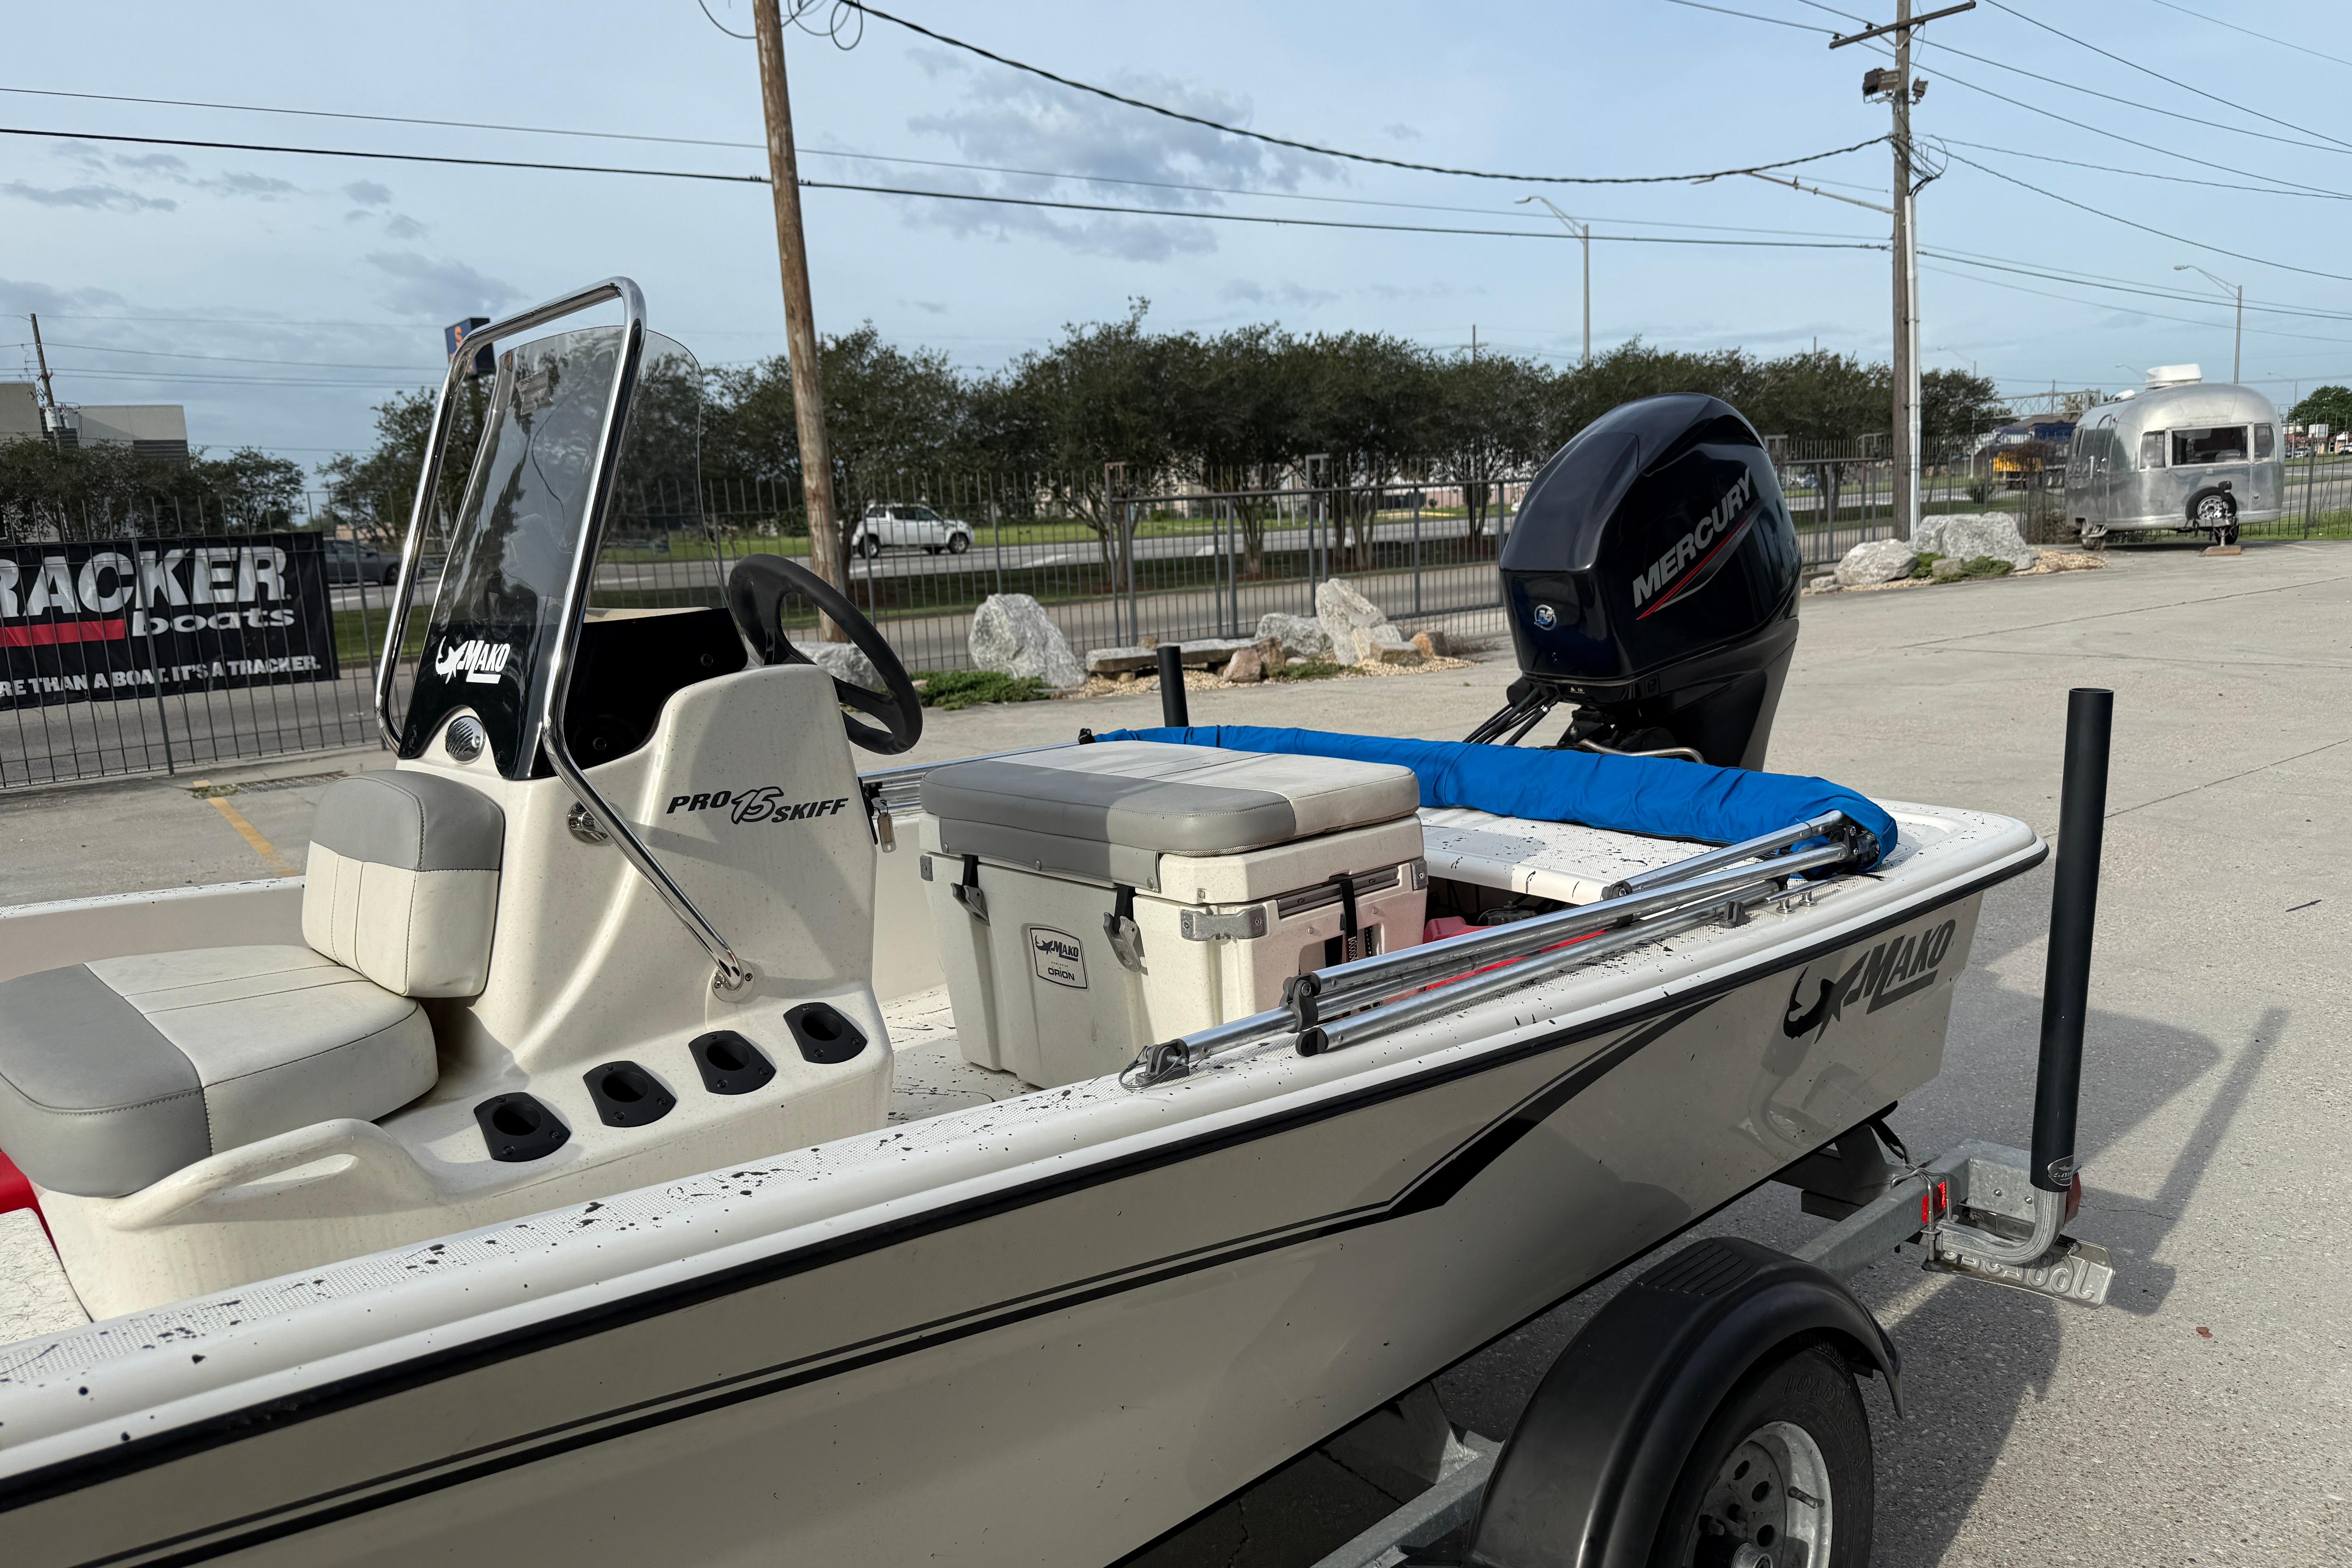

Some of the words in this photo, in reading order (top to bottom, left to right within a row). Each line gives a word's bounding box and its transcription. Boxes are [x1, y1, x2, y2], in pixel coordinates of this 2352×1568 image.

[1633, 467, 1750, 608] MERCURY
[132, 607, 295, 637] boats
[28, 674, 89, 693] THAN
[94, 673, 109, 689] A
[171, 663, 209, 682] IT'S
[212, 661, 225, 677] A
[227, 655, 322, 676] TRACKER.
[457, 640, 511, 684] MAKO
[666, 791, 732, 814] PRO
[731, 786, 784, 825] 15
[771, 798, 849, 823] SKIFF
[1051, 940, 1079, 962] MAKO
[1843, 919, 1956, 1015] MAKO
[1048, 967, 1075, 981] ORION
[1783, 1374, 1836, 1402] LOAD
[1841, 1415, 1869, 1496] STAR
